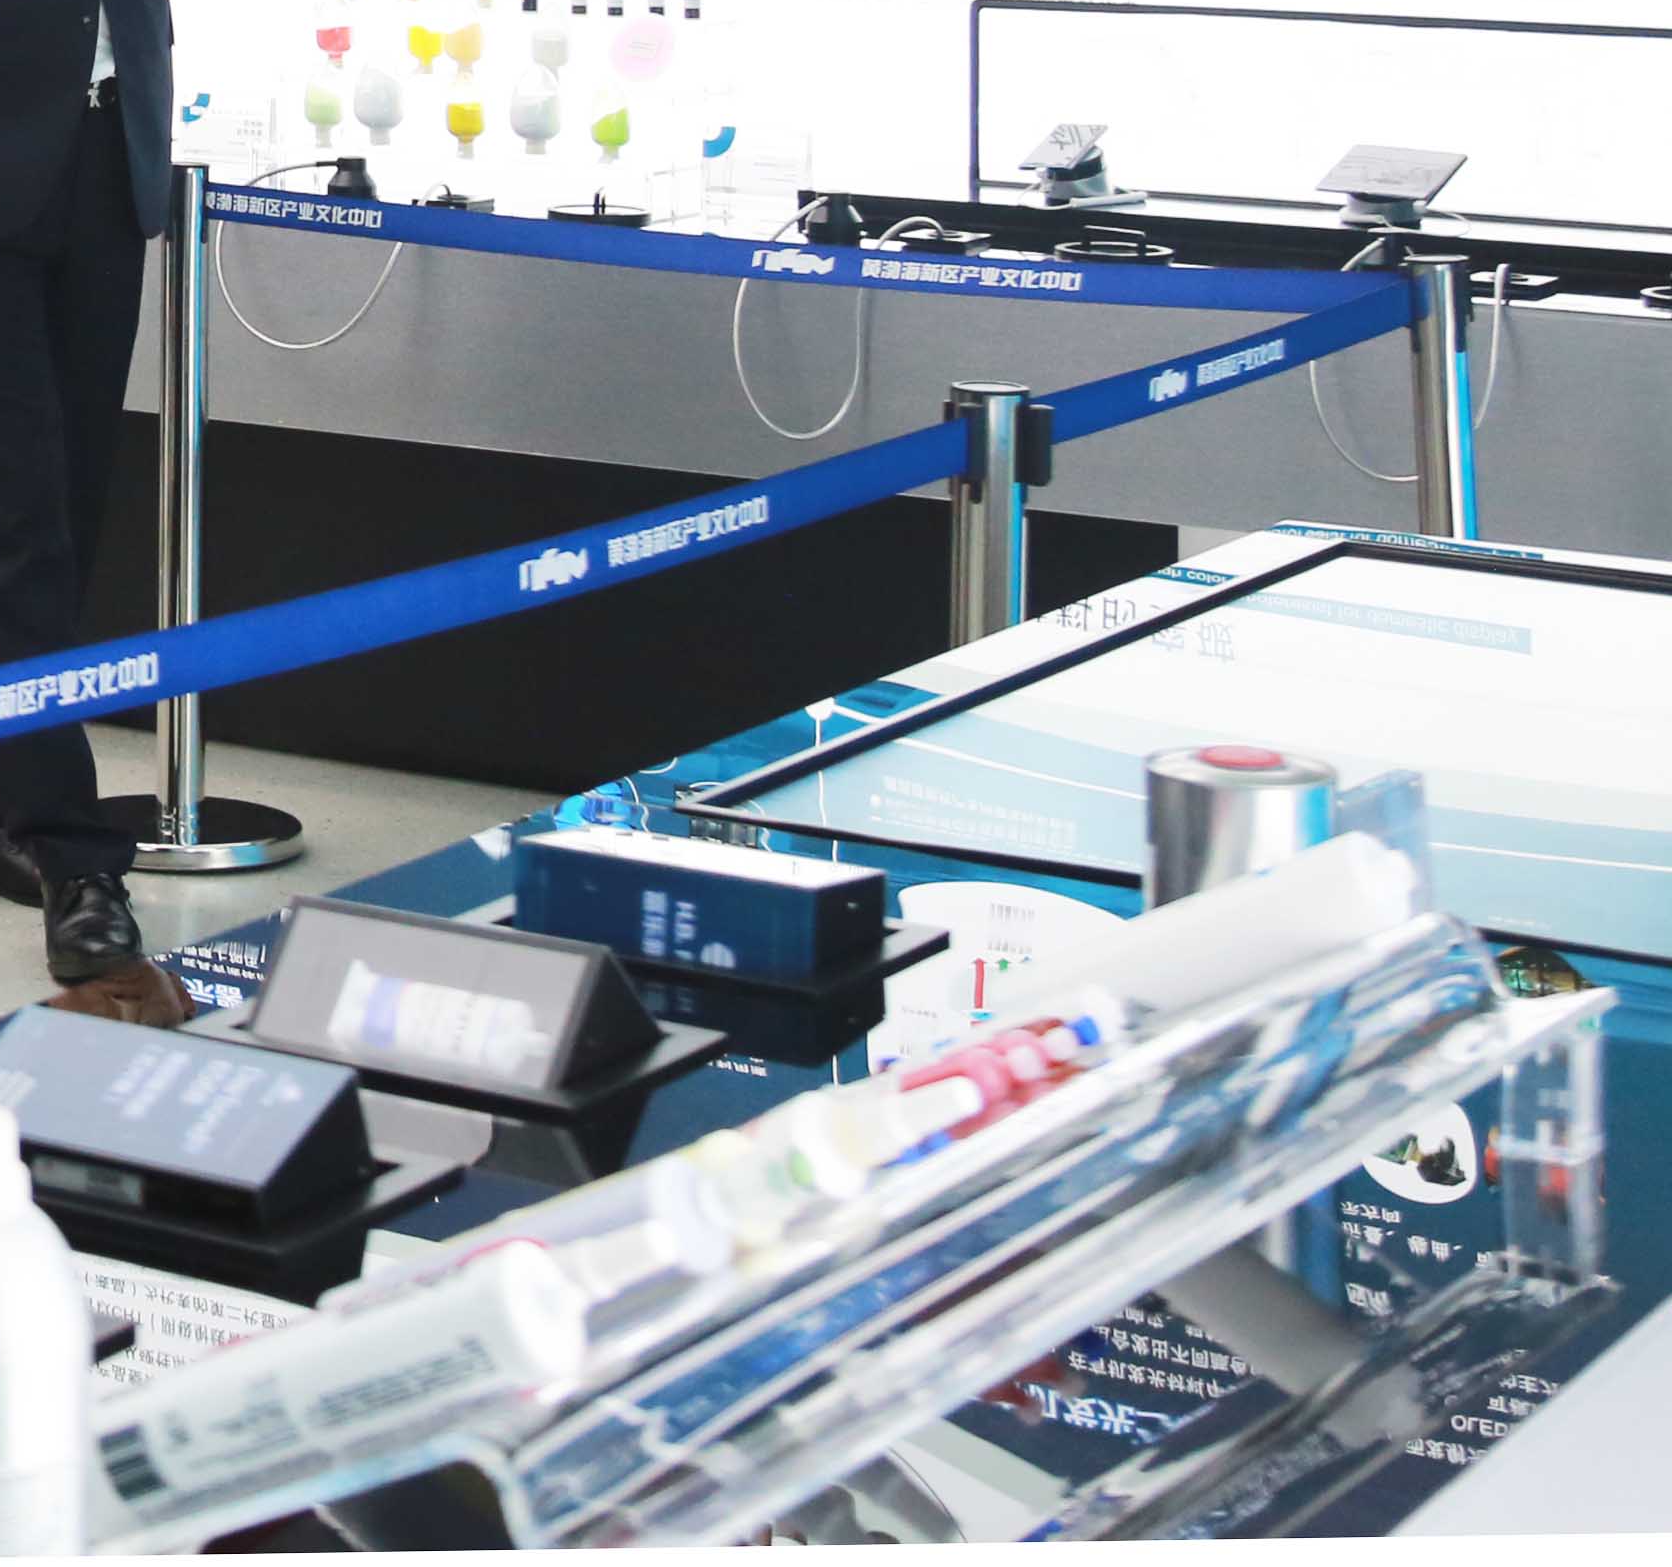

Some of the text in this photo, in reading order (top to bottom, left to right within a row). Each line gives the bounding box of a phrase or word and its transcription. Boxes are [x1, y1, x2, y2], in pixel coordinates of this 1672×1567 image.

[861, 258, 1082, 292] 黄渤海新区产业文化中心
